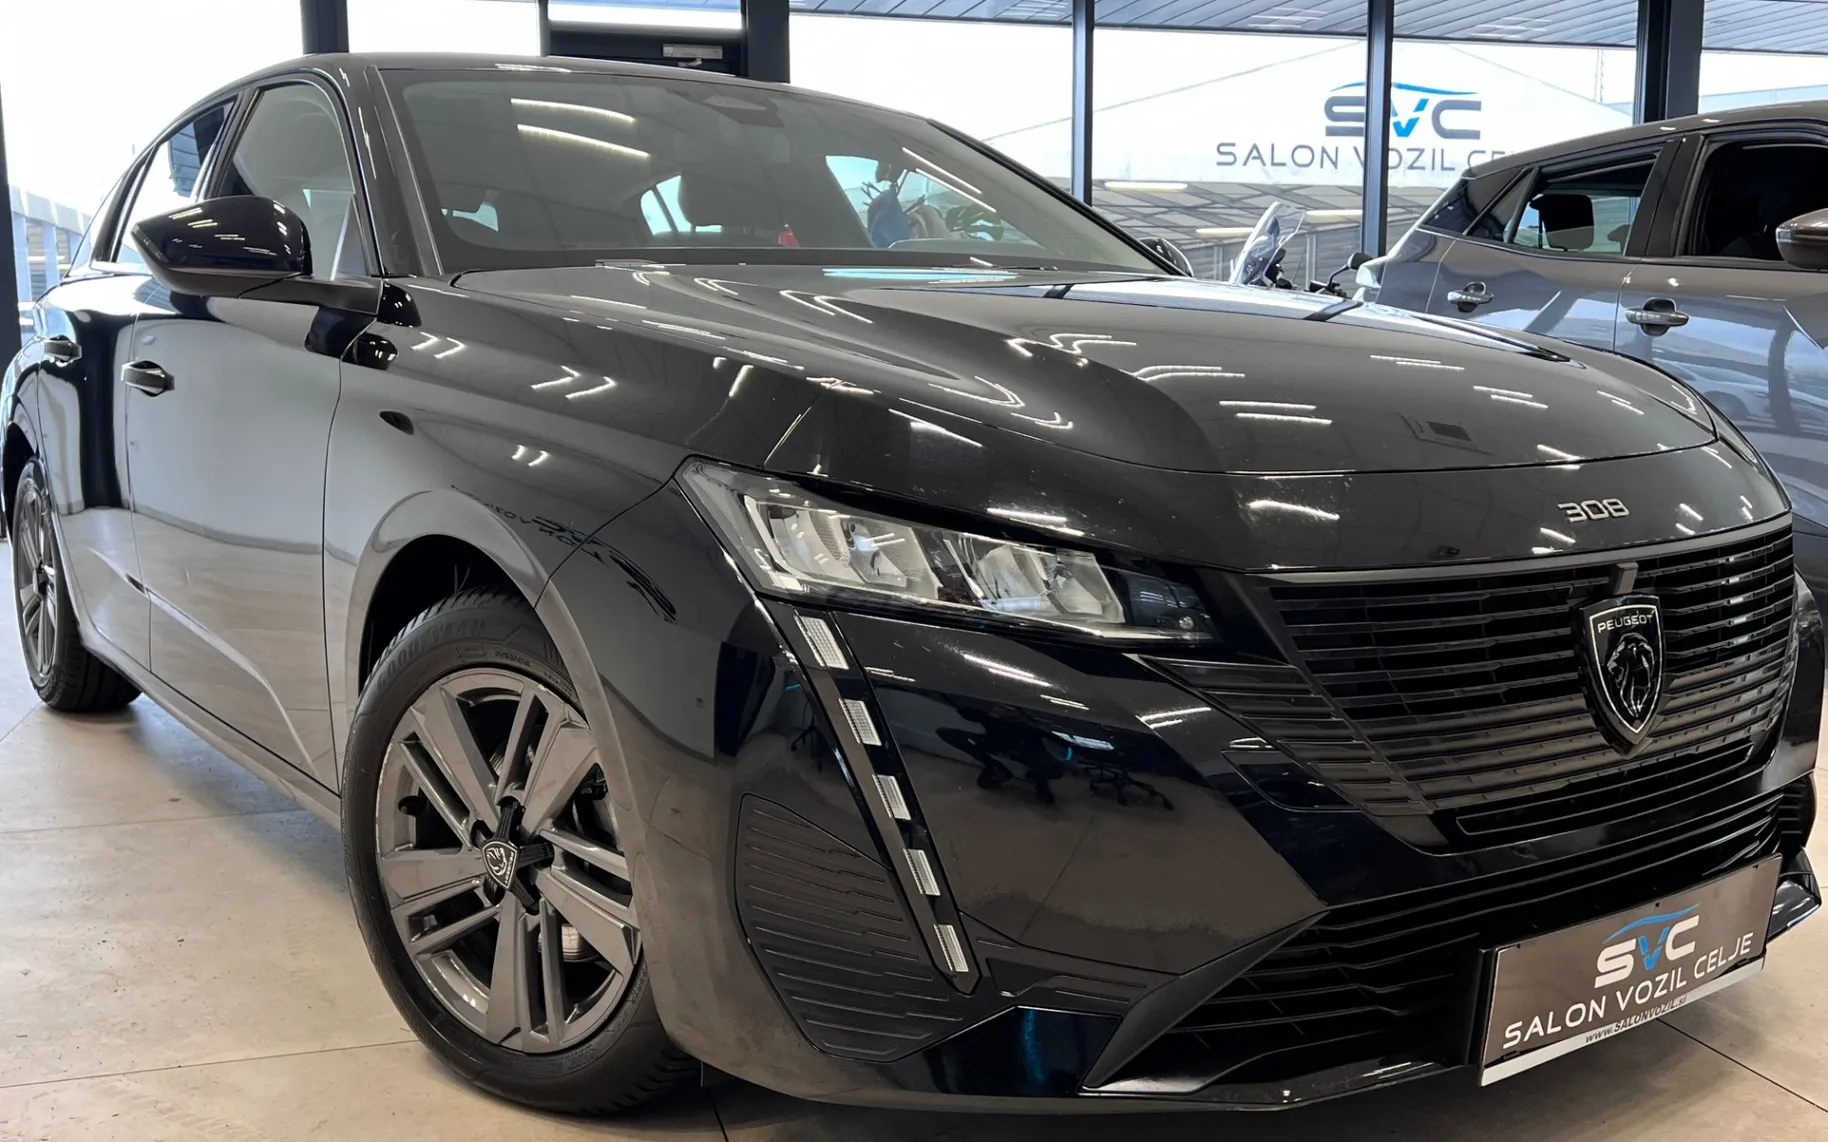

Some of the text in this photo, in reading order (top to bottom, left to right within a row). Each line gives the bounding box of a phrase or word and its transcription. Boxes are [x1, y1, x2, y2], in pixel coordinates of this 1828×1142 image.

[1324, 95, 1482, 140] SVC
[1216, 142, 1339, 169] SALON
[1557, 498, 1630, 523] 308
[1598, 613, 1654, 633] PEUGEOT
[1594, 915, 1700, 989] SVC
[1502, 931, 1755, 1050] SALON VOZIL CELJE
